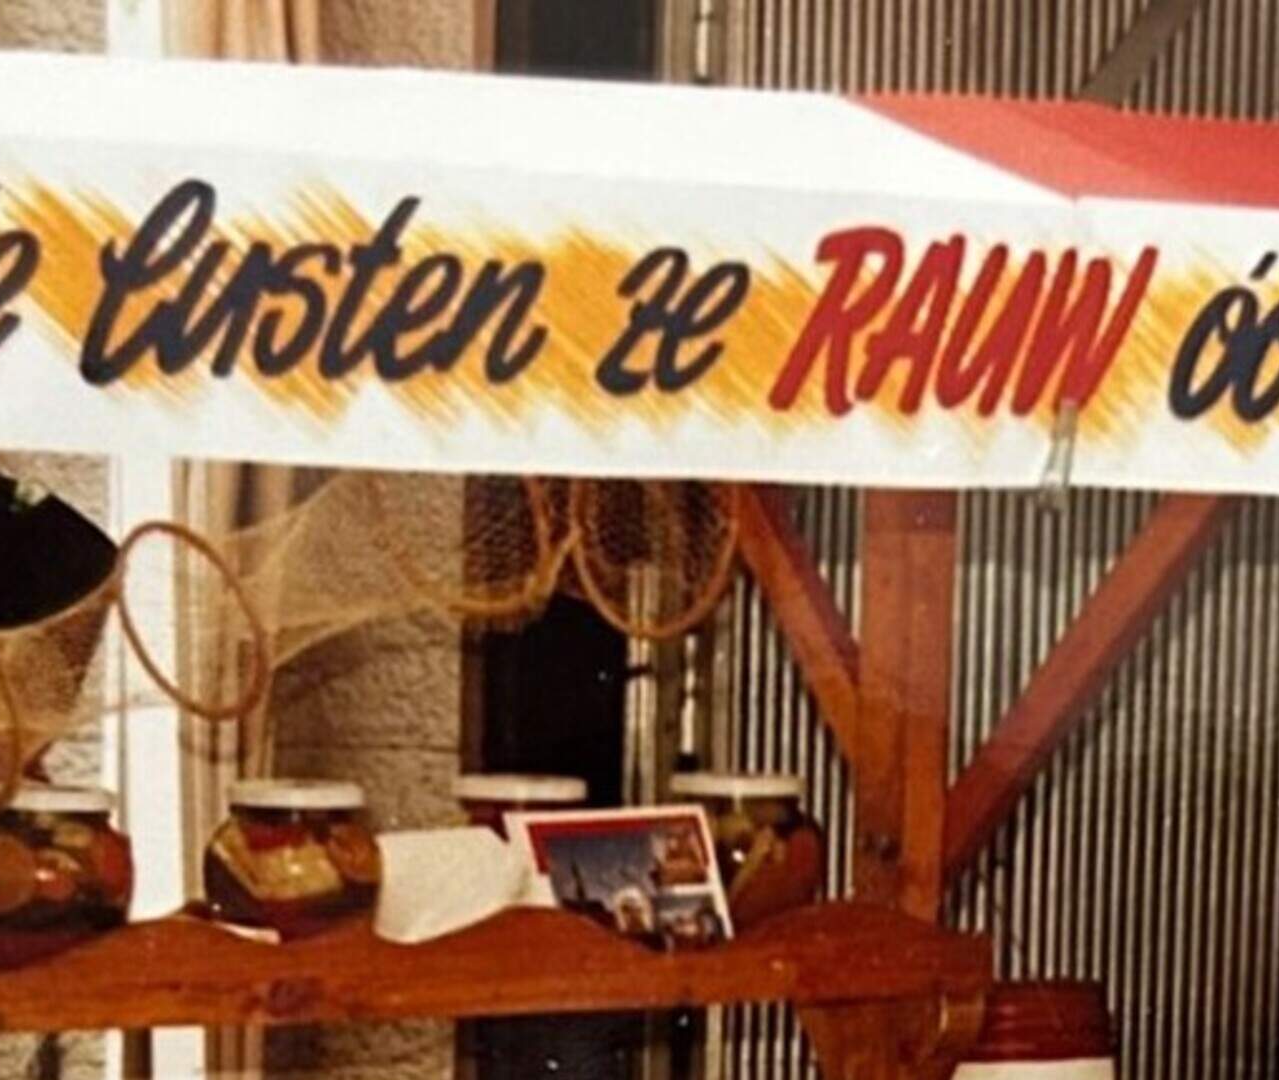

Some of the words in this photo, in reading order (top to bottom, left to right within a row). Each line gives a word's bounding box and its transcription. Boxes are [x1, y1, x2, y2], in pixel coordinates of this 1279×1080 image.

[78, 179, 547, 387] lusten
[595, 246, 750, 397] ze
[768, 227, 1158, 417] RAUW
